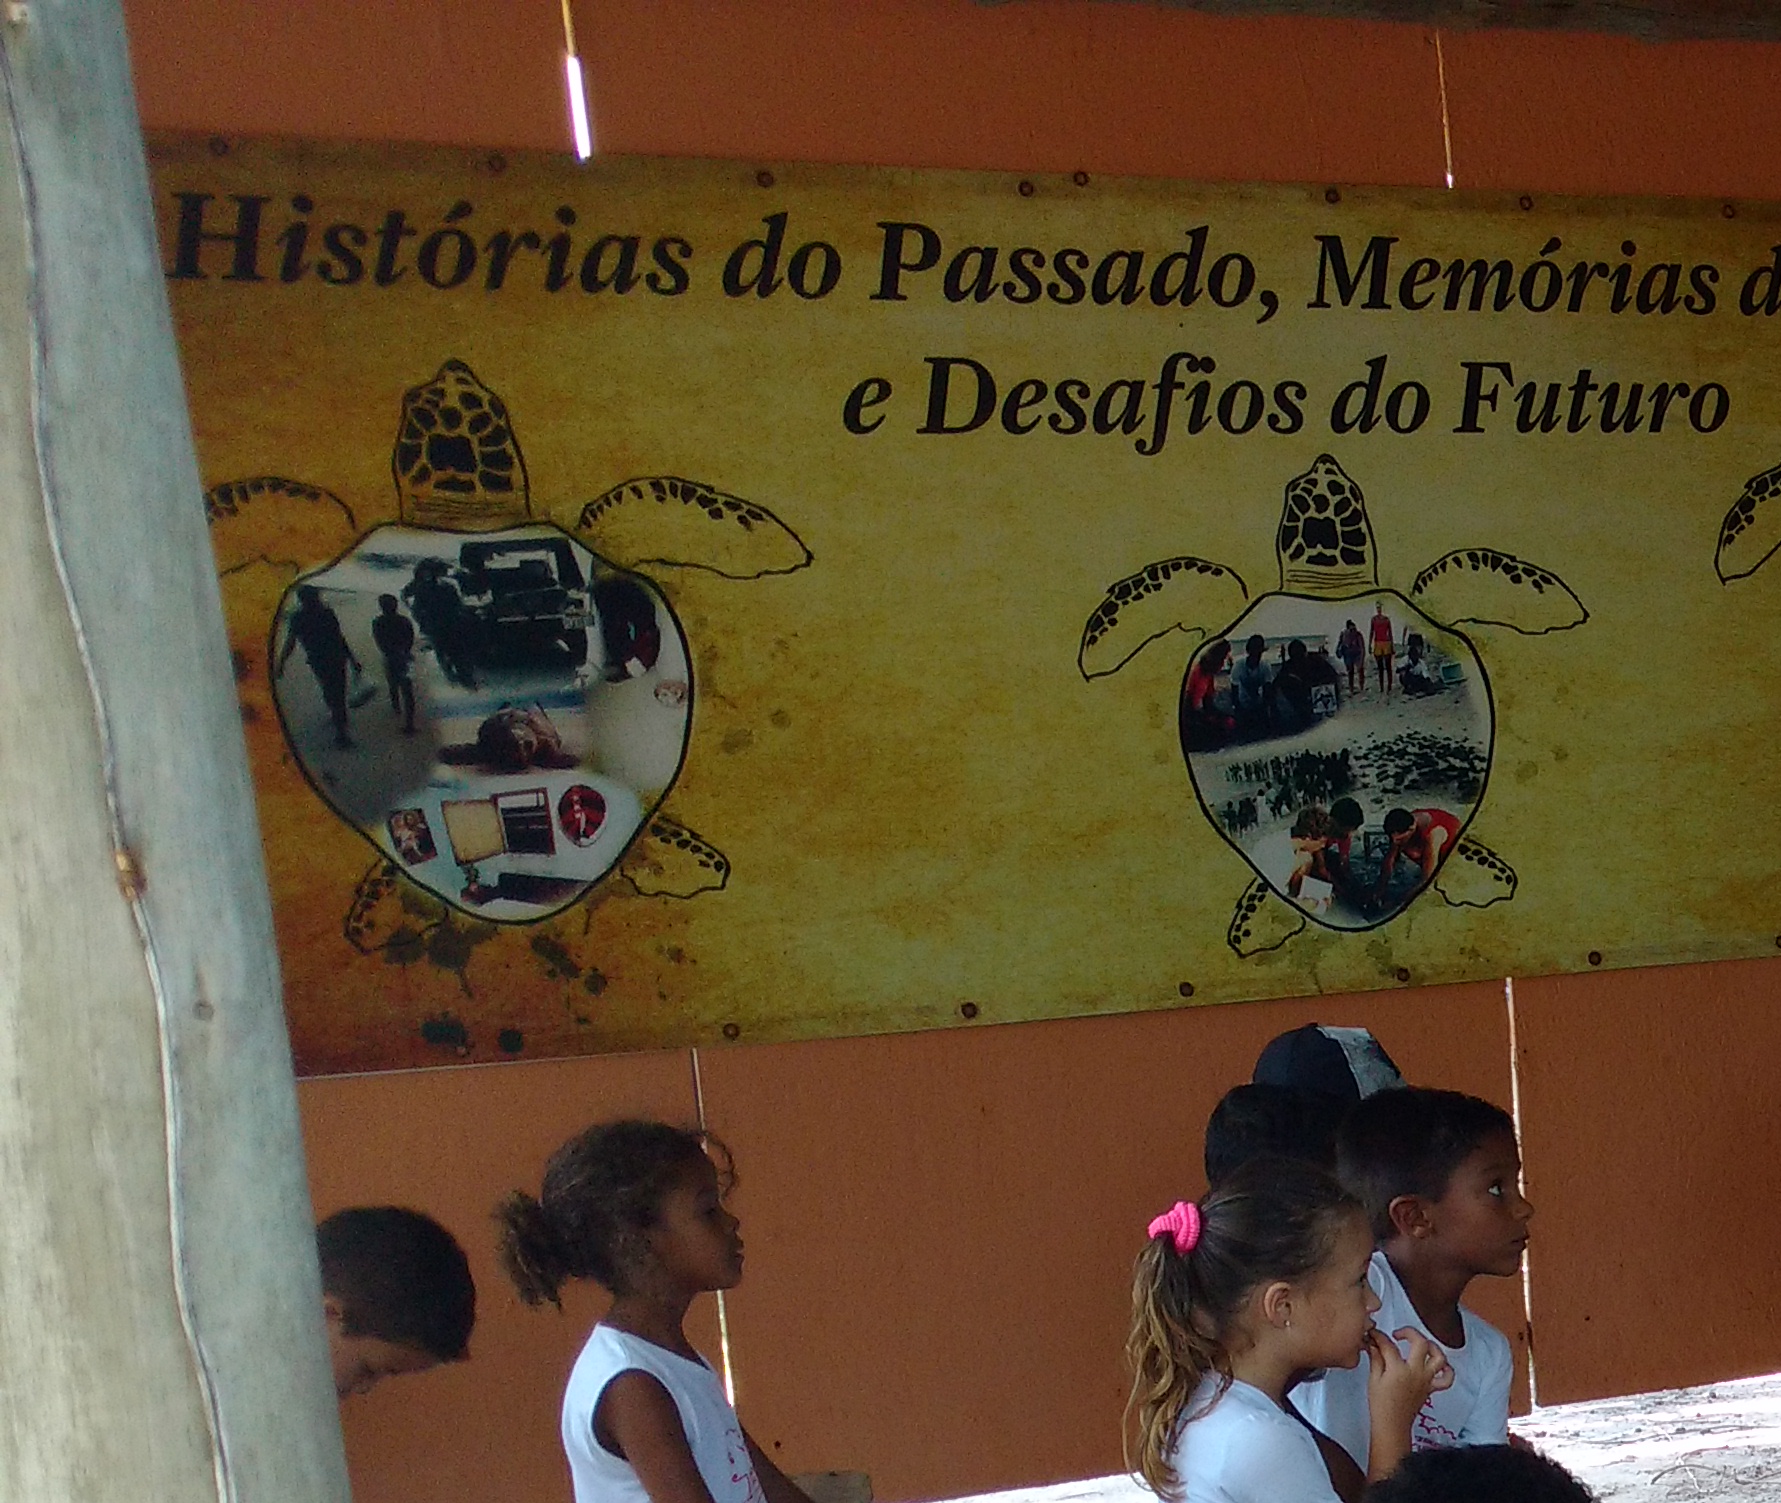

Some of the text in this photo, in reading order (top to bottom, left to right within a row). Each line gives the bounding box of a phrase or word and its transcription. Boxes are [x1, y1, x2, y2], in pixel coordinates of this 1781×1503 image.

[165, 187, 694, 298] Histórias
[722, 211, 842, 299] do
[868, 219, 1282, 325] Passado,
[1306, 233, 1718, 317] Memórias
[840, 353, 1731, 456] e Desafios do Futuro
